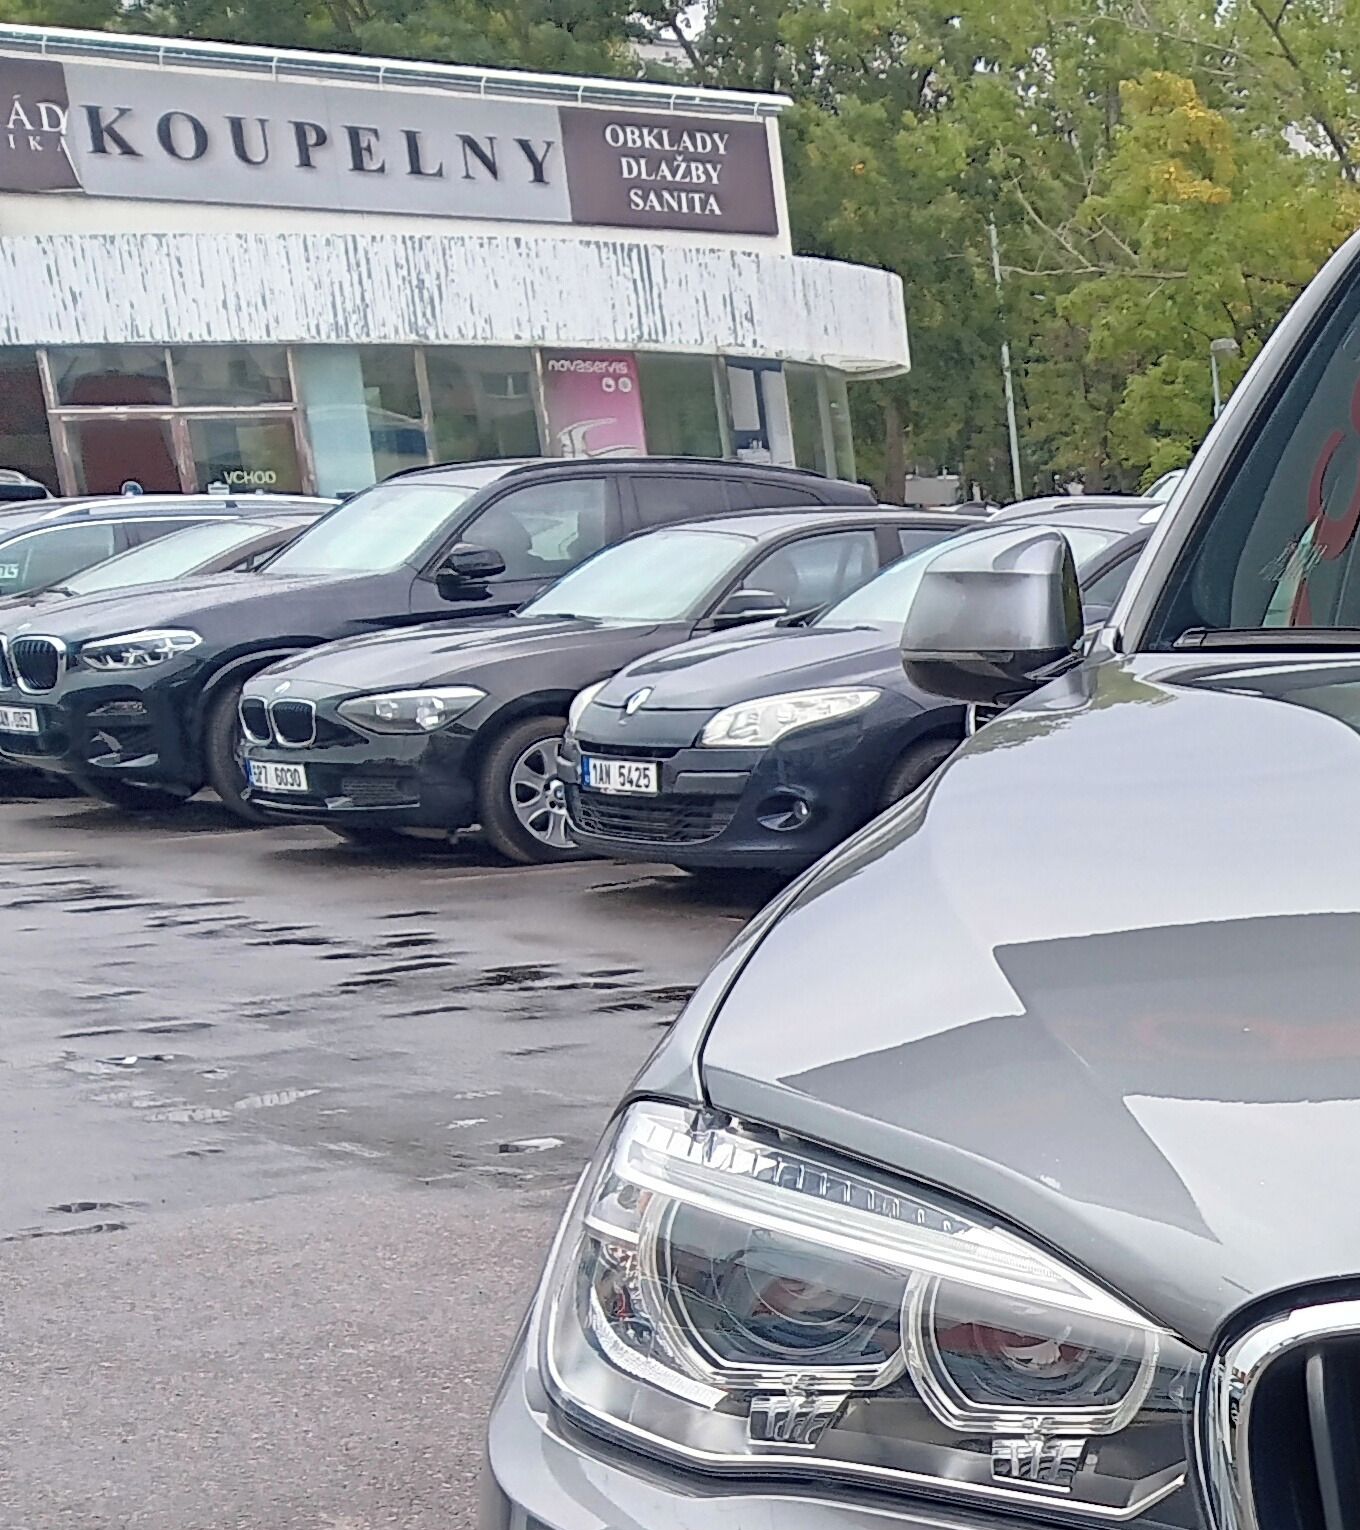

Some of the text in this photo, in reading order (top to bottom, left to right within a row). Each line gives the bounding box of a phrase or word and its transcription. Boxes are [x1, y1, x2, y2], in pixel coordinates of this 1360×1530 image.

[80, 104, 554, 184] KOUPELNY
[604, 124, 729, 155] OBKLADY
[620, 154, 722, 184] DLAŽBY
[629, 188, 722, 215] SANITA
[548, 359, 628, 374] novaservis
[223, 470, 277, 484] VCHOD
[274, 766, 302, 787] 6030
[592, 763, 651, 788] 1AN 5425
